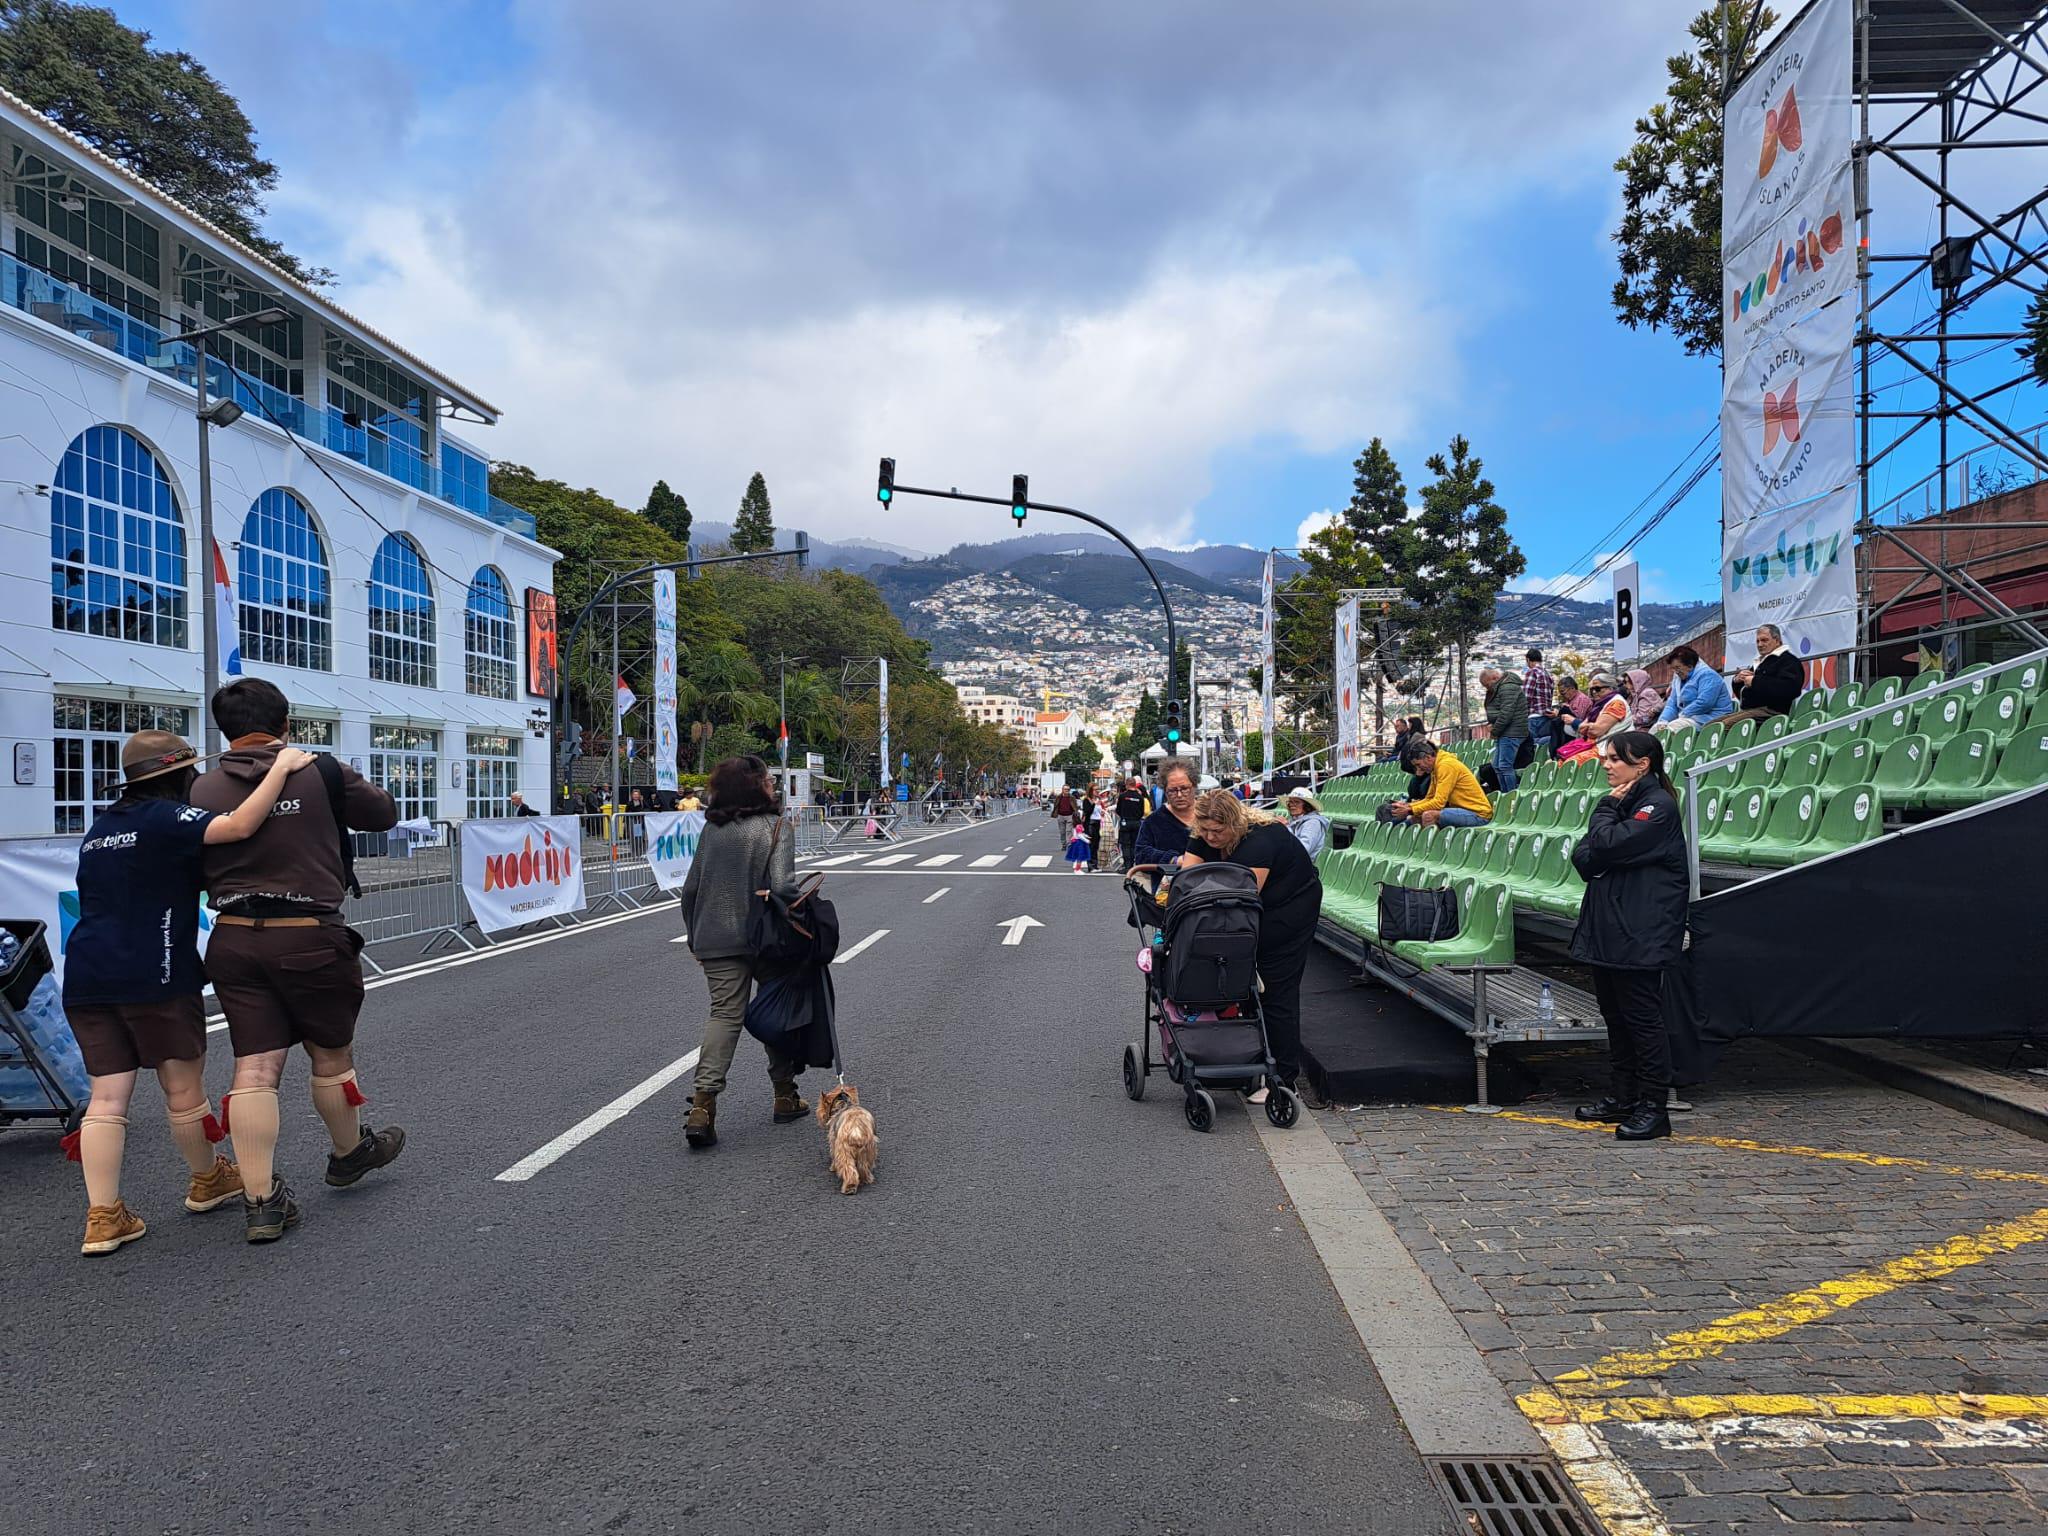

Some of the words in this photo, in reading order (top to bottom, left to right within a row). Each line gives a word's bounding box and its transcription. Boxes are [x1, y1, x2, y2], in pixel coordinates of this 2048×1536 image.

[1761, 52, 1805, 110] MADEIRA
[1758, 150, 1806, 205] ISLANDS
[1774, 295, 1800, 319] PORTO
[1801, 279, 1827, 302] SANTO
[1759, 348, 1807, 393] MADEIRA
[1755, 463, 1781, 491] PORTO
[1782, 441, 1813, 488] SANTO
[1617, 588, 1634, 640] B
[81, 831, 138, 853] escoteiros
[510, 900, 535, 914] MADEIRA
